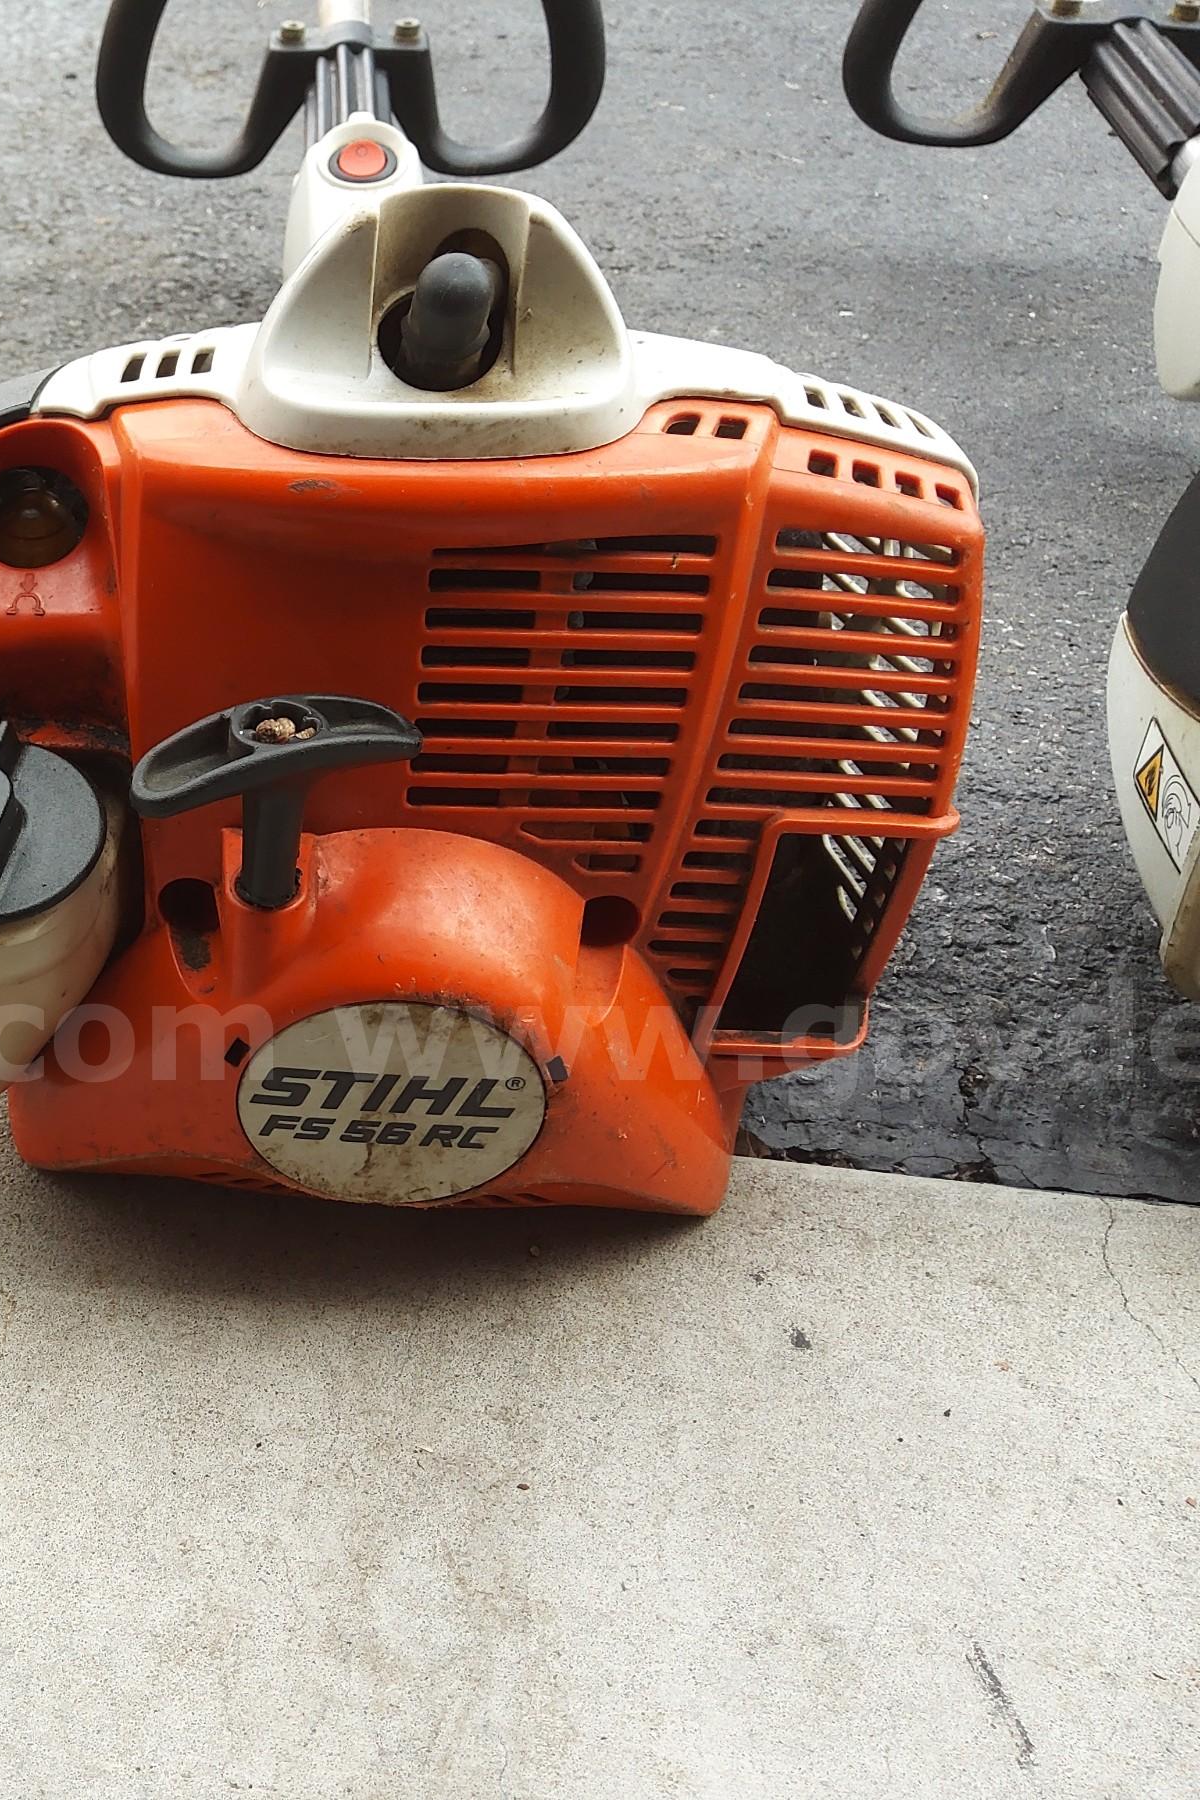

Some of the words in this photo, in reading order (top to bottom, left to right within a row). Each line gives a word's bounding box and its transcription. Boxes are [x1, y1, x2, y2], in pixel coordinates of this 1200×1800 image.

[258, 1114, 336, 1141] FS
[339, 1120, 417, 1146] 56
[418, 1125, 500, 1150] RC
